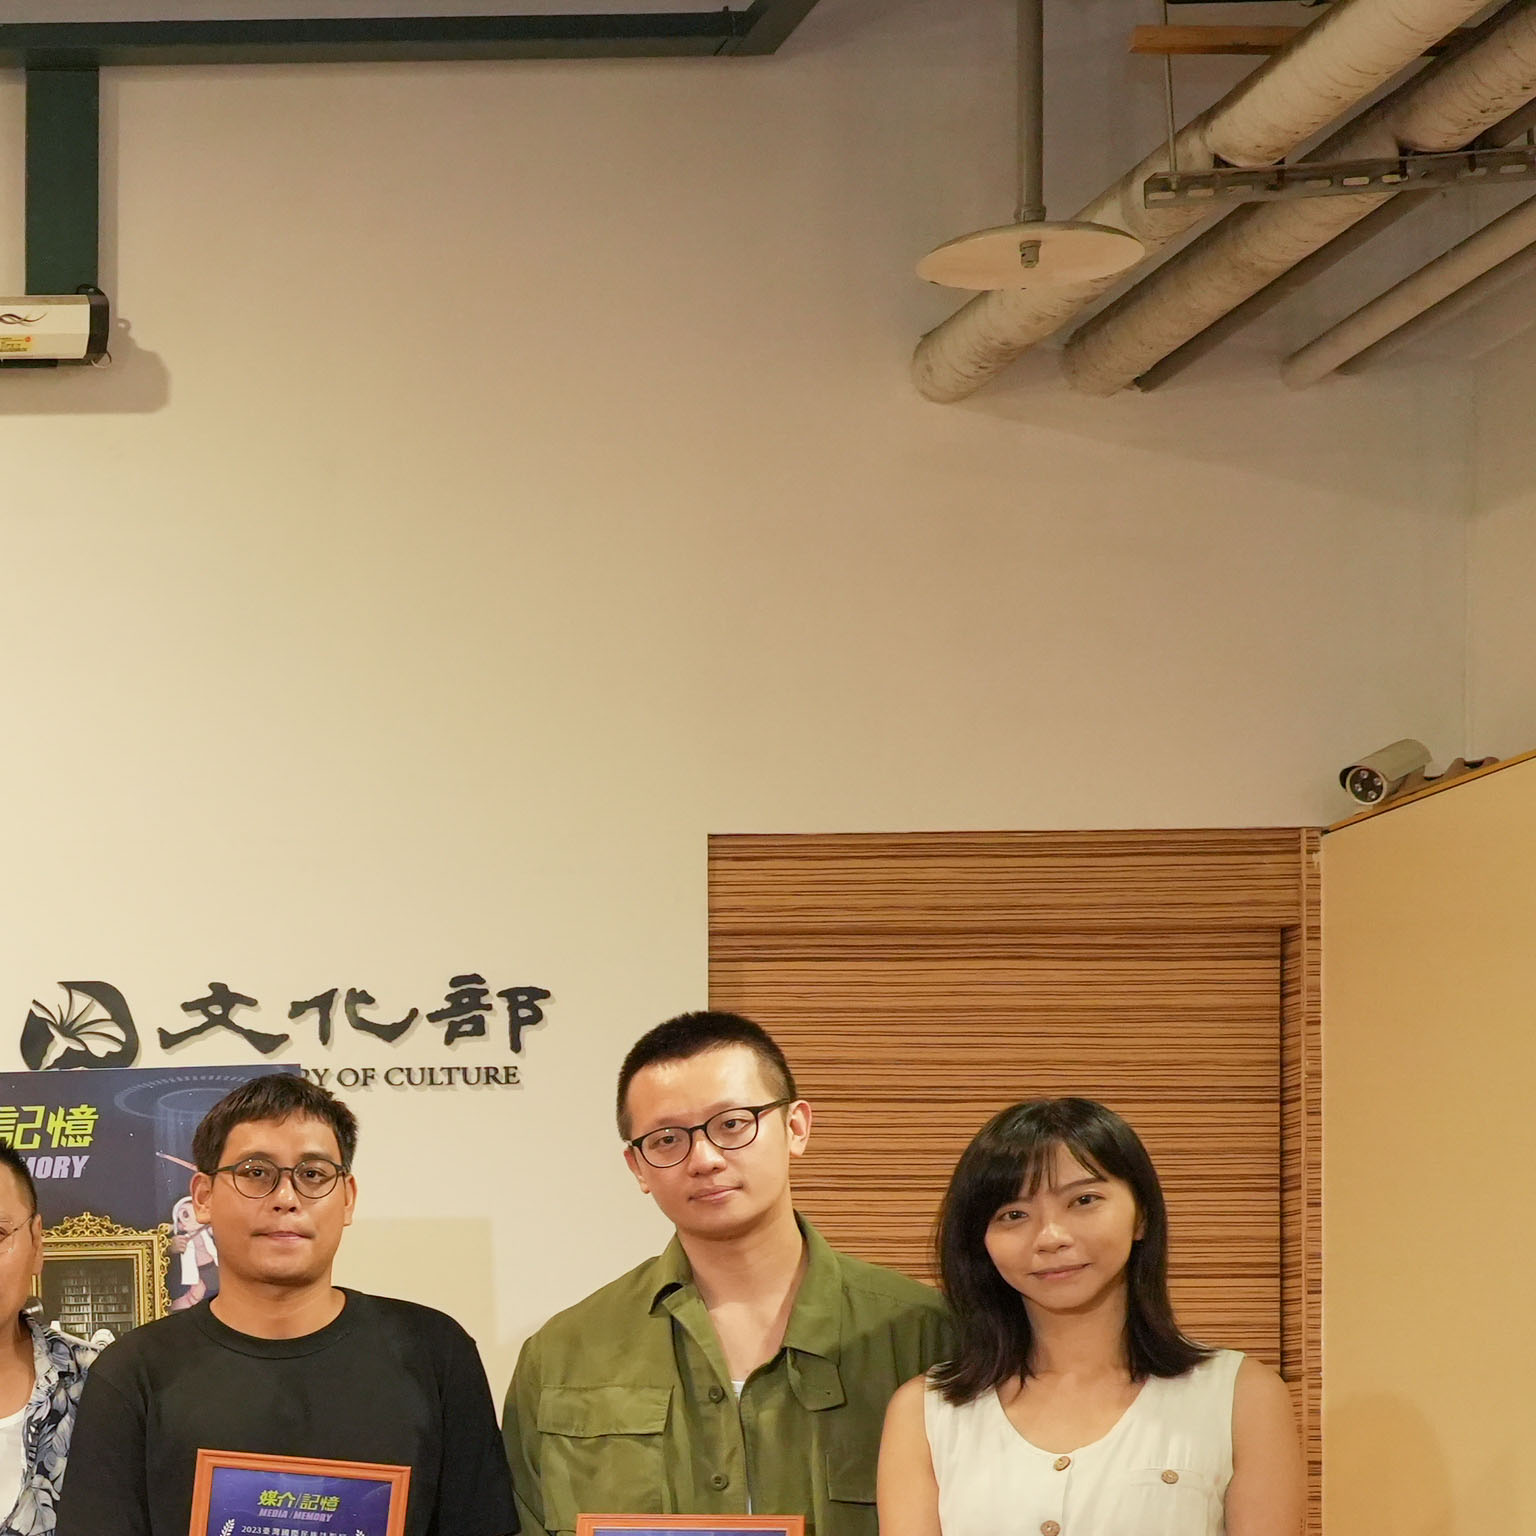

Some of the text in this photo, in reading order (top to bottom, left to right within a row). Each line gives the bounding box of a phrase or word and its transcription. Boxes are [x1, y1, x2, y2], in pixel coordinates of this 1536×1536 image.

[157, 973, 551, 1054] 文化部
[337, 1068, 376, 1087] OF
[384, 1066, 521, 1087] CULTURE
